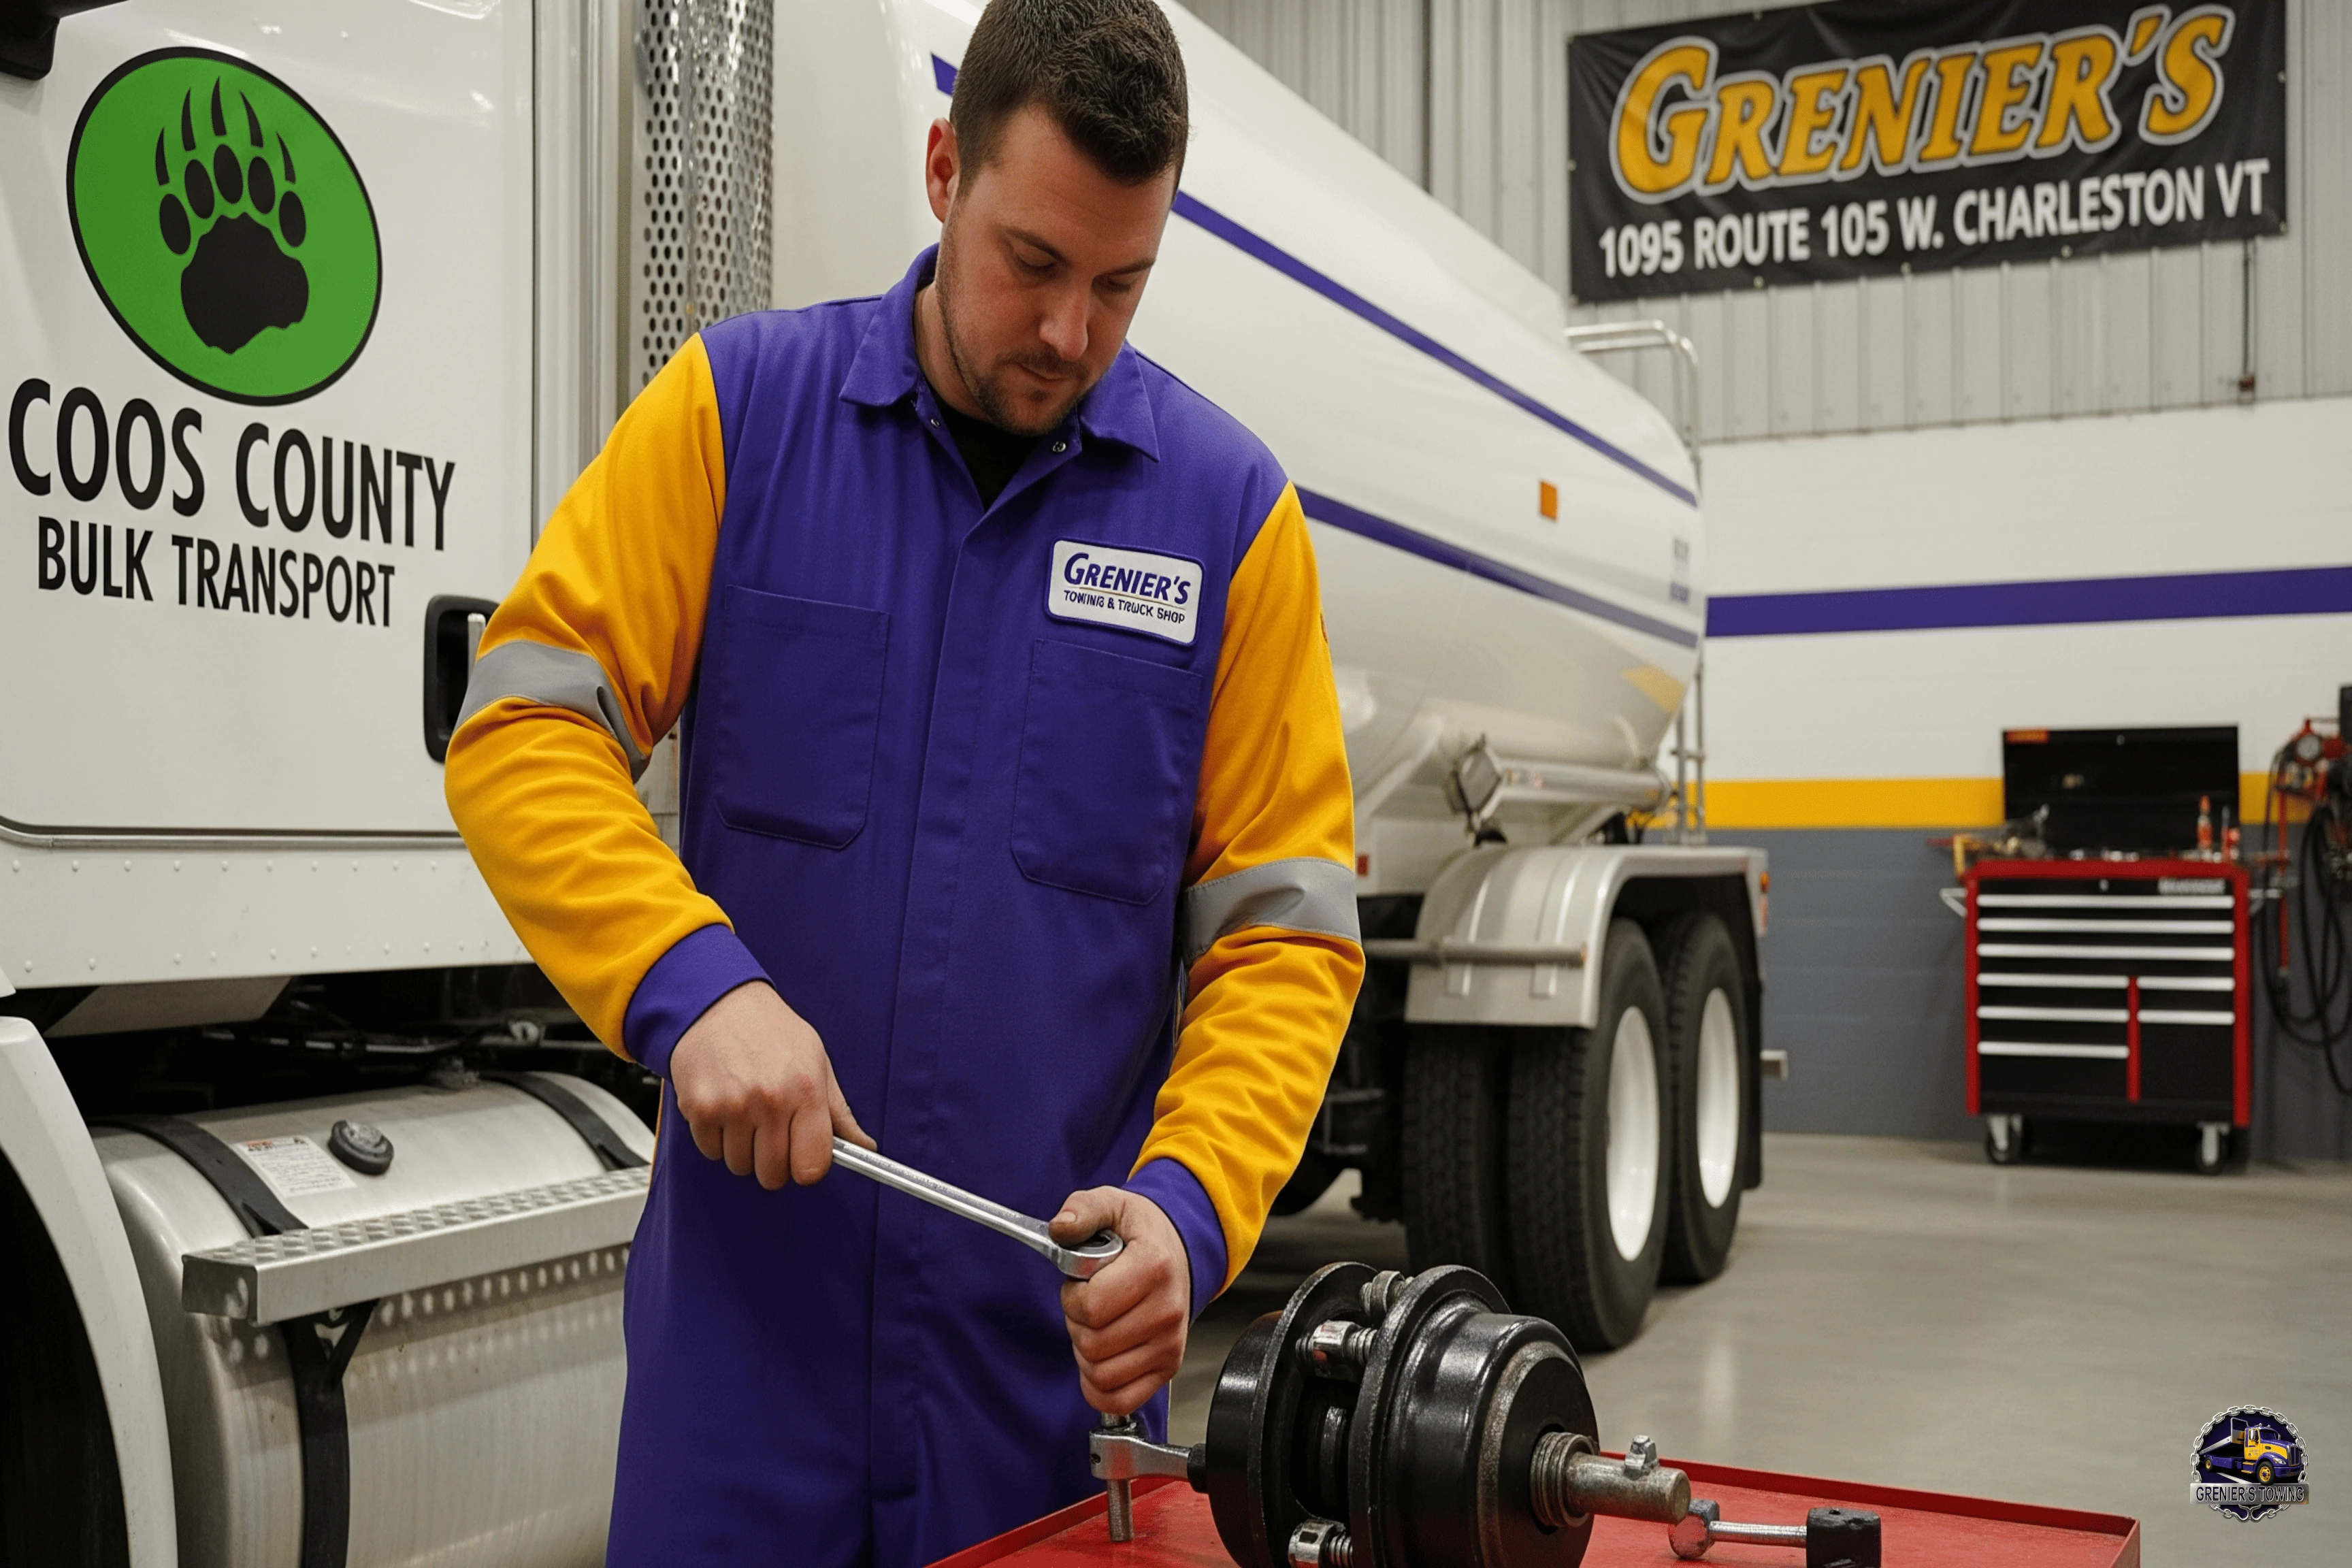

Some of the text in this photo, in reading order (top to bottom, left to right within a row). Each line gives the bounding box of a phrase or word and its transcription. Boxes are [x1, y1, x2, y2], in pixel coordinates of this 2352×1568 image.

[1610, 3, 2234, 203] GRENIER'S
[1599, 158, 2270, 278] 1095 ROUTE 105 W. CHARLESTON VT
[8, 378, 456, 552] COOS COUNTY
[38, 515, 395, 627] BULK TRANSPORT
[1064, 552, 1191, 604] GRENIER'S
[1107, 597, 1115, 610] &
[1118, 599, 1154, 617] TRUCK
[1157, 607, 1186, 624] SHOP
